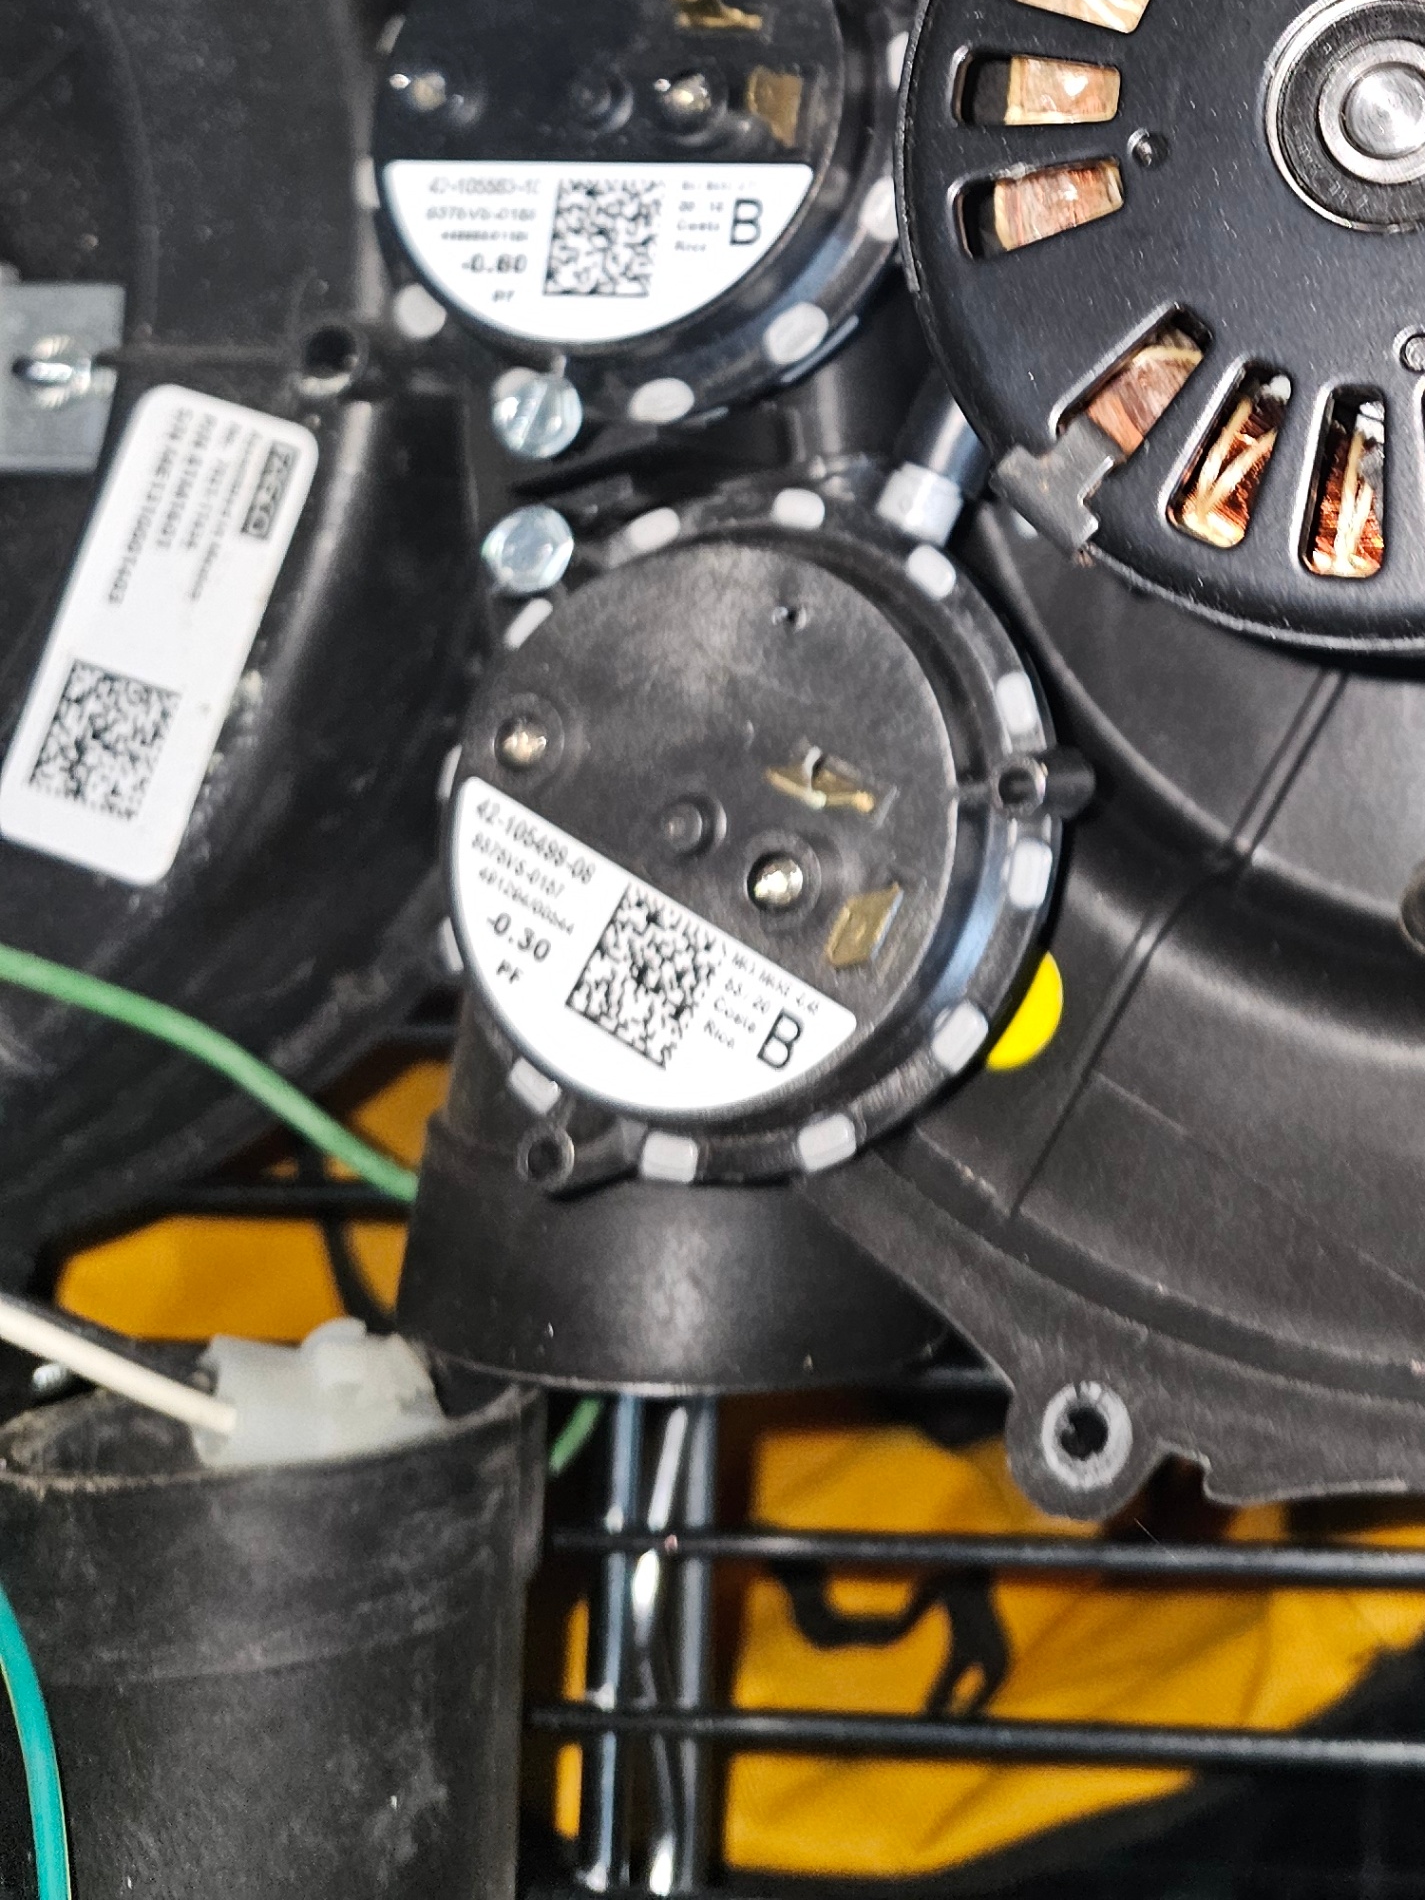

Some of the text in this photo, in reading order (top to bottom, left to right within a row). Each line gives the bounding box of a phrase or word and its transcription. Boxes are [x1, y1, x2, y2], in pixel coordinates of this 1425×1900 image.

[729, 196, 764, 247] B
[486, 910, 552, 963] -0.30
[756, 1006, 803, 1071] B
